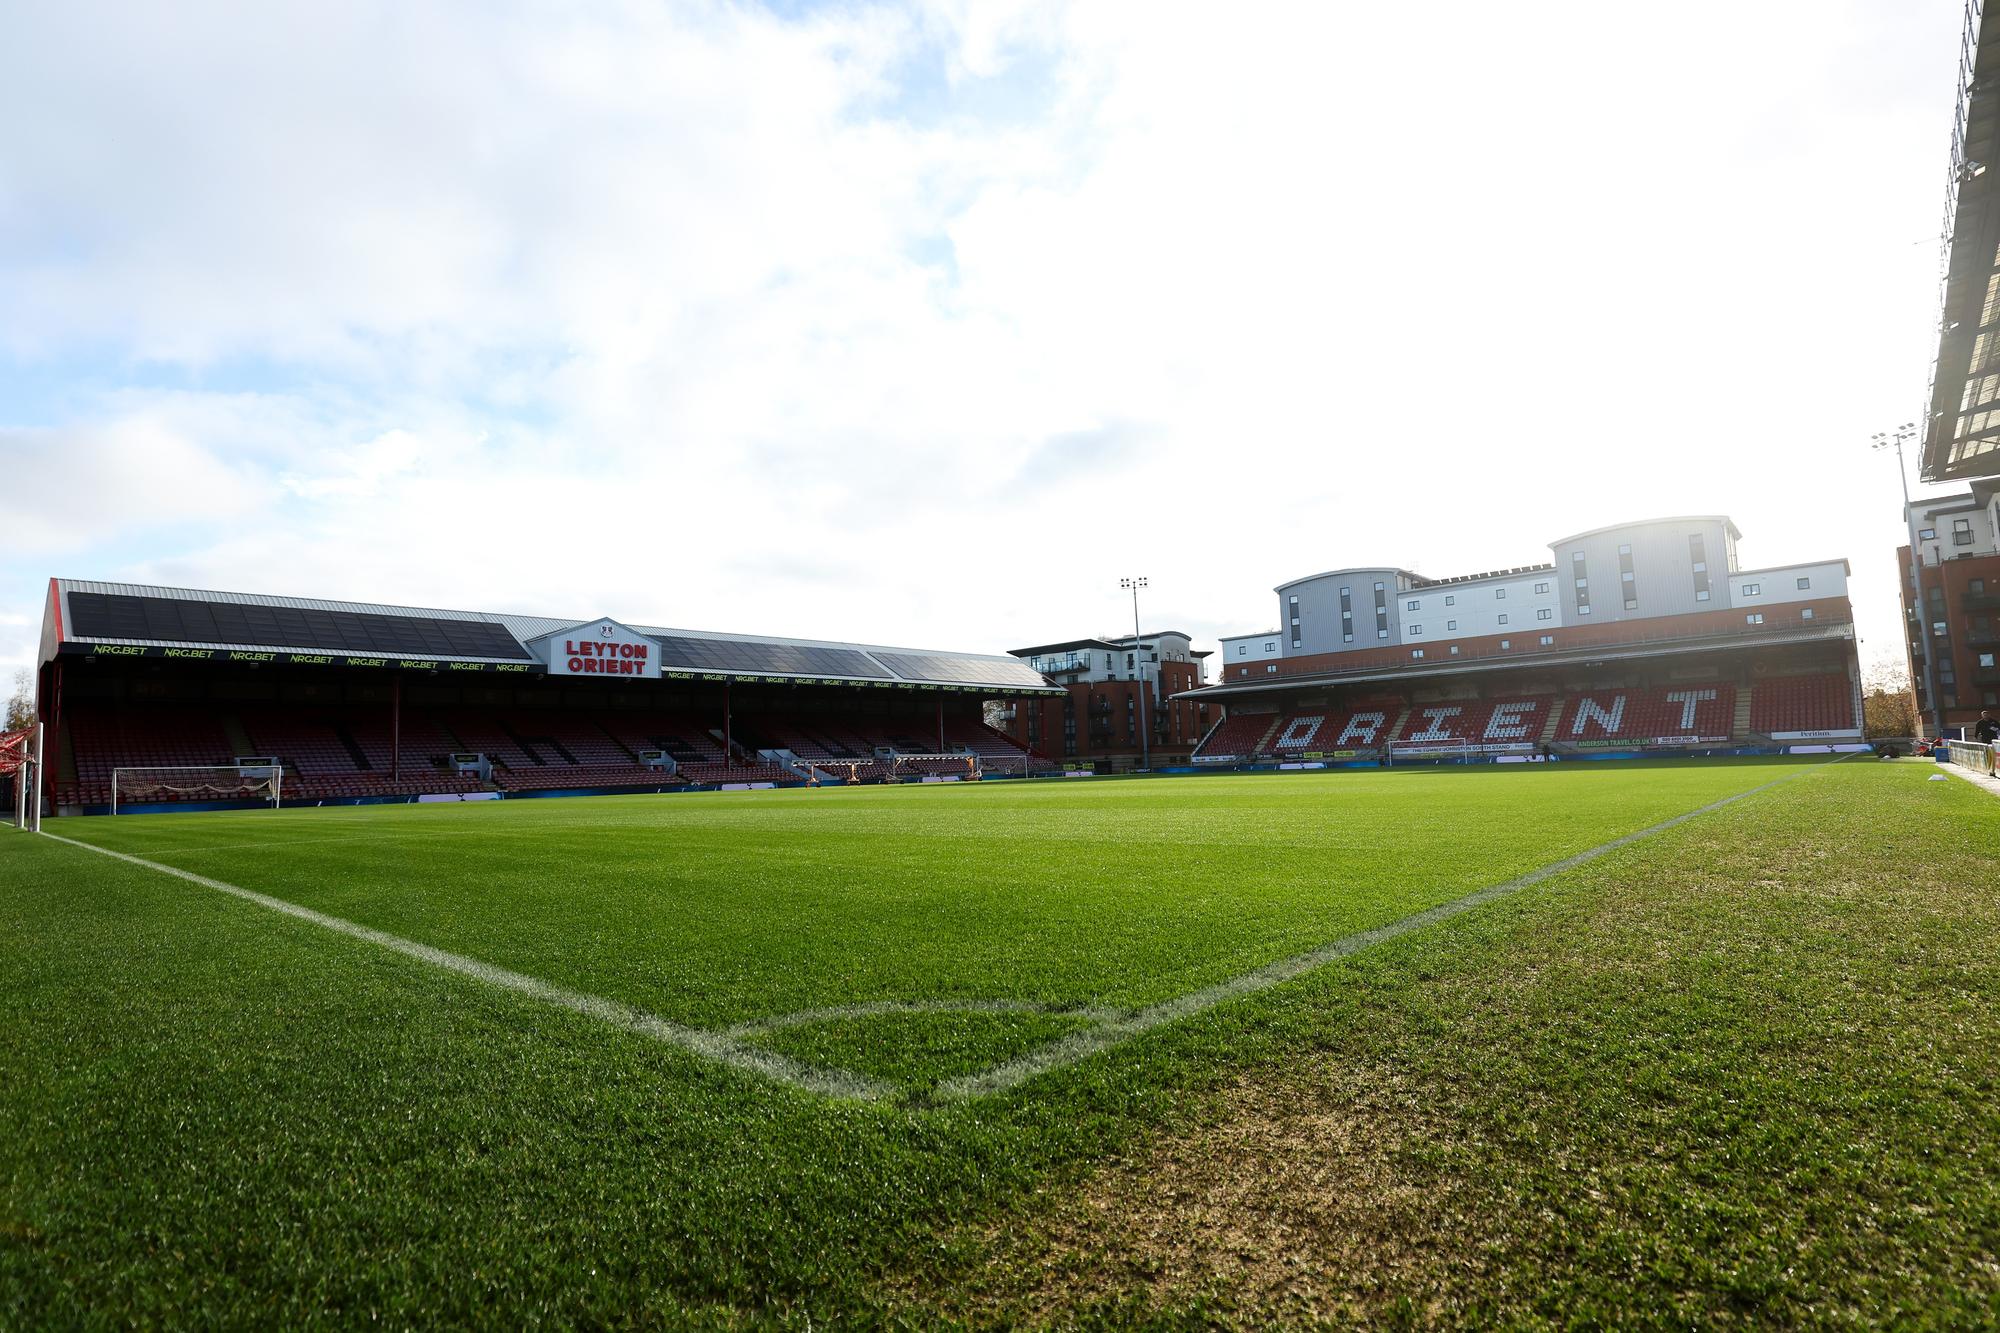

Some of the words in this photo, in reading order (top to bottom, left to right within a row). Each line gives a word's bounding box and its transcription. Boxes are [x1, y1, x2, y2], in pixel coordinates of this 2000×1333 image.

[93, 644, 147, 655] NRG.BET
[164, 648, 214, 658] NRG.BET
[566, 641, 647, 658] LEYTON
[230, 651, 276, 661] NRG.BET
[290, 654, 334, 664] NRG.BET
[347, 657, 388, 667] NRG.BET
[400, 660, 438, 669] NRG.BET
[450, 662, 485, 671] NRG.BET
[568, 658, 645, 674] ORIENT
[496, 664, 530, 672] NRG.BET
[668, 672, 695, 680] NRG.BET
[1276, 689, 1717, 748] ORIENT
[1578, 739, 1609, 747] ANDERSON
